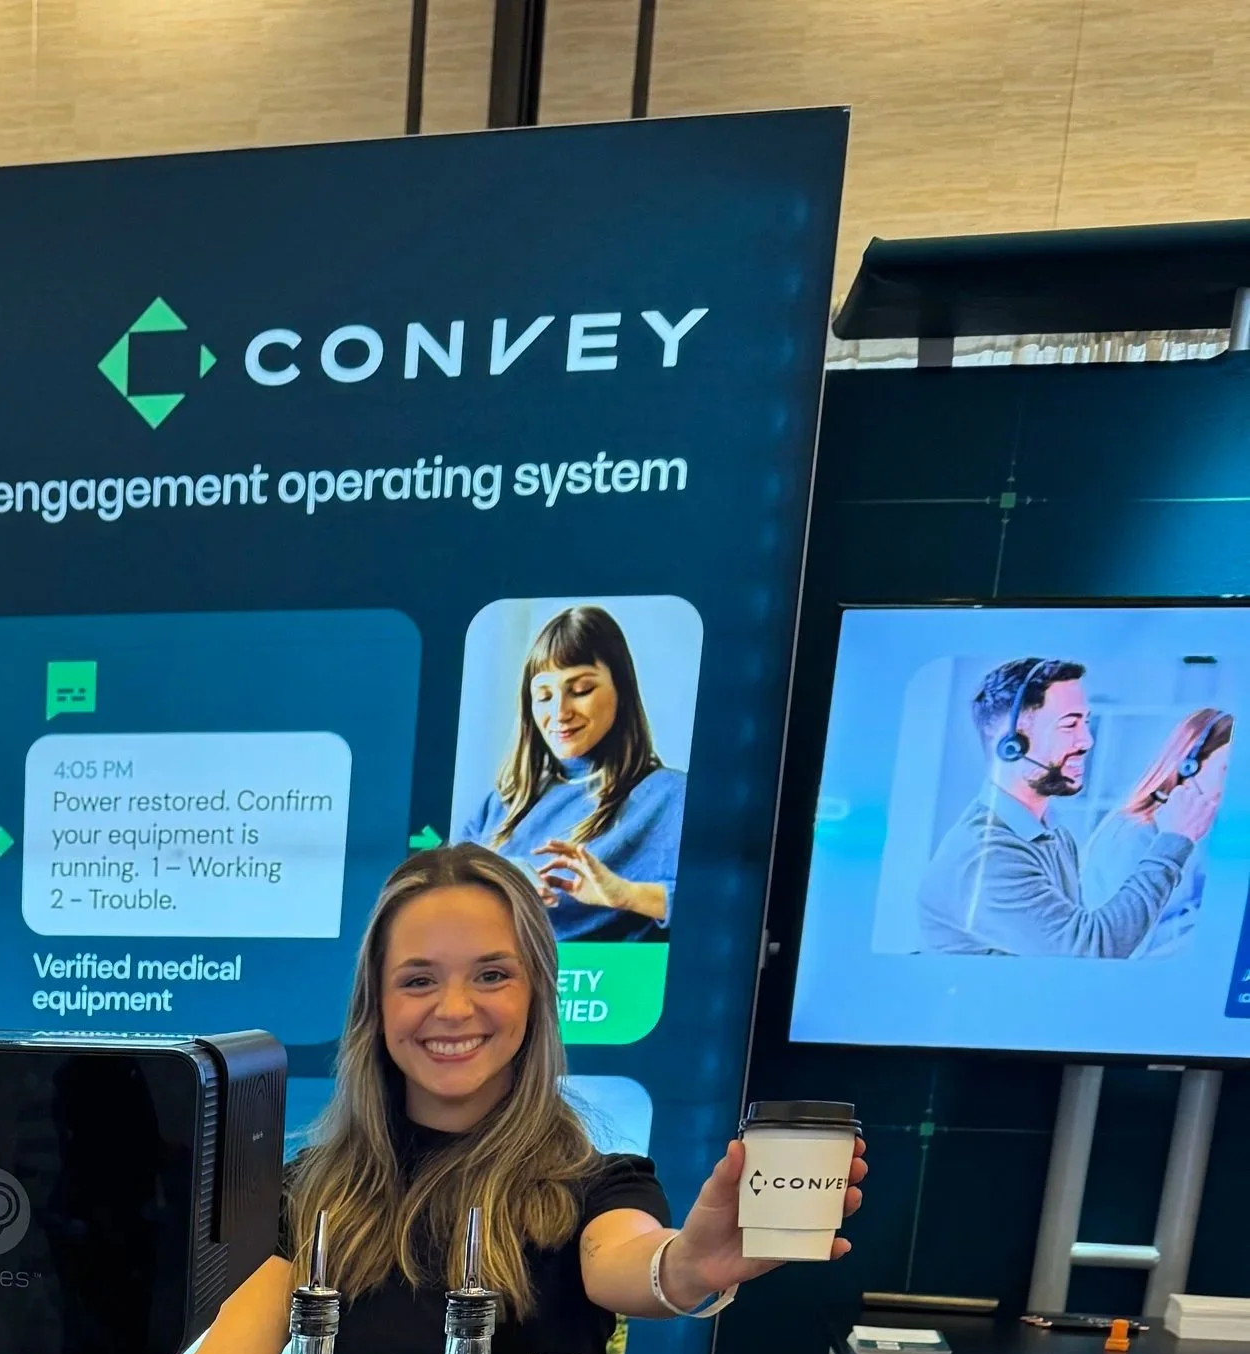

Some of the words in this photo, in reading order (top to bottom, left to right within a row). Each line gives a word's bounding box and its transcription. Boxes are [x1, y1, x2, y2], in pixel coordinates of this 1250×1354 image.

[245, 308, 709, 387] CONVEY
[278, 454, 501, 513] operating
[513, 452, 688, 507] system
[54, 761, 97, 779] 4:05
[103, 761, 133, 779] PM
[53, 791, 121, 812] Power
[128, 790, 229, 811] restored.
[237, 790, 332, 811] Confirm
[51, 829, 102, 850] your
[108, 824, 234, 850] equipment
[242, 823, 259, 844] is
[51, 857, 139, 883] running.
[152, 857, 159, 877] 1
[189, 856, 282, 883] Working
[51, 889, 63, 909] 2
[89, 888, 177, 911] Trouble.
[33, 953, 131, 980] Verified
[138, 954, 241, 981] medical
[557, 970, 604, 992] ETY
[32, 985, 173, 1016] equipment
[773, 1177, 847, 1190] CONVE
